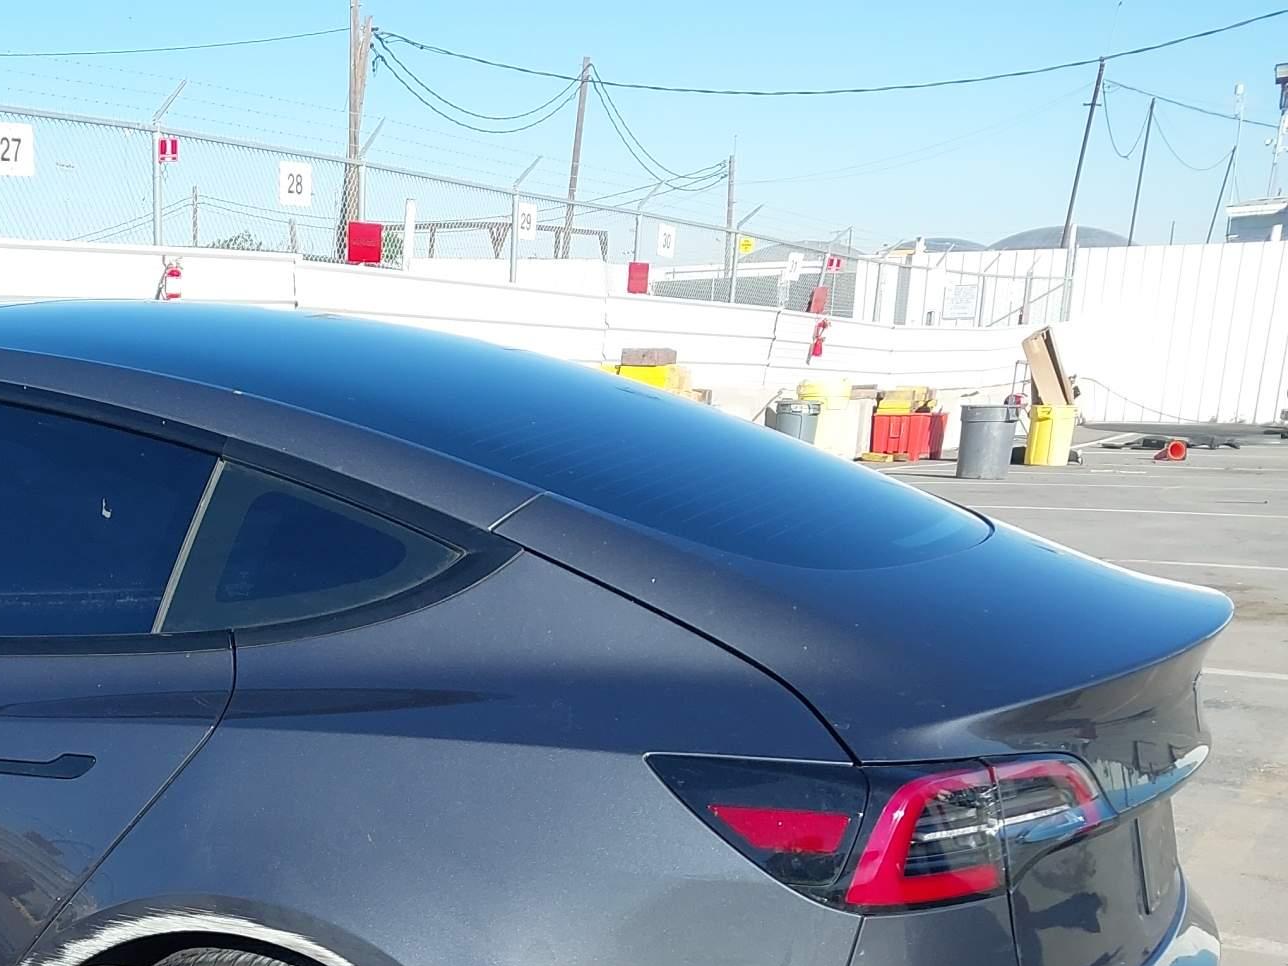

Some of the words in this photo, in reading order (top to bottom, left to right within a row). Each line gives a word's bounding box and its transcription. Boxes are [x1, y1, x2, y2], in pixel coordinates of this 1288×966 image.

[0, 136, 22, 162] 27
[287, 173, 303, 195] 28
[520, 212, 532, 231] 29
